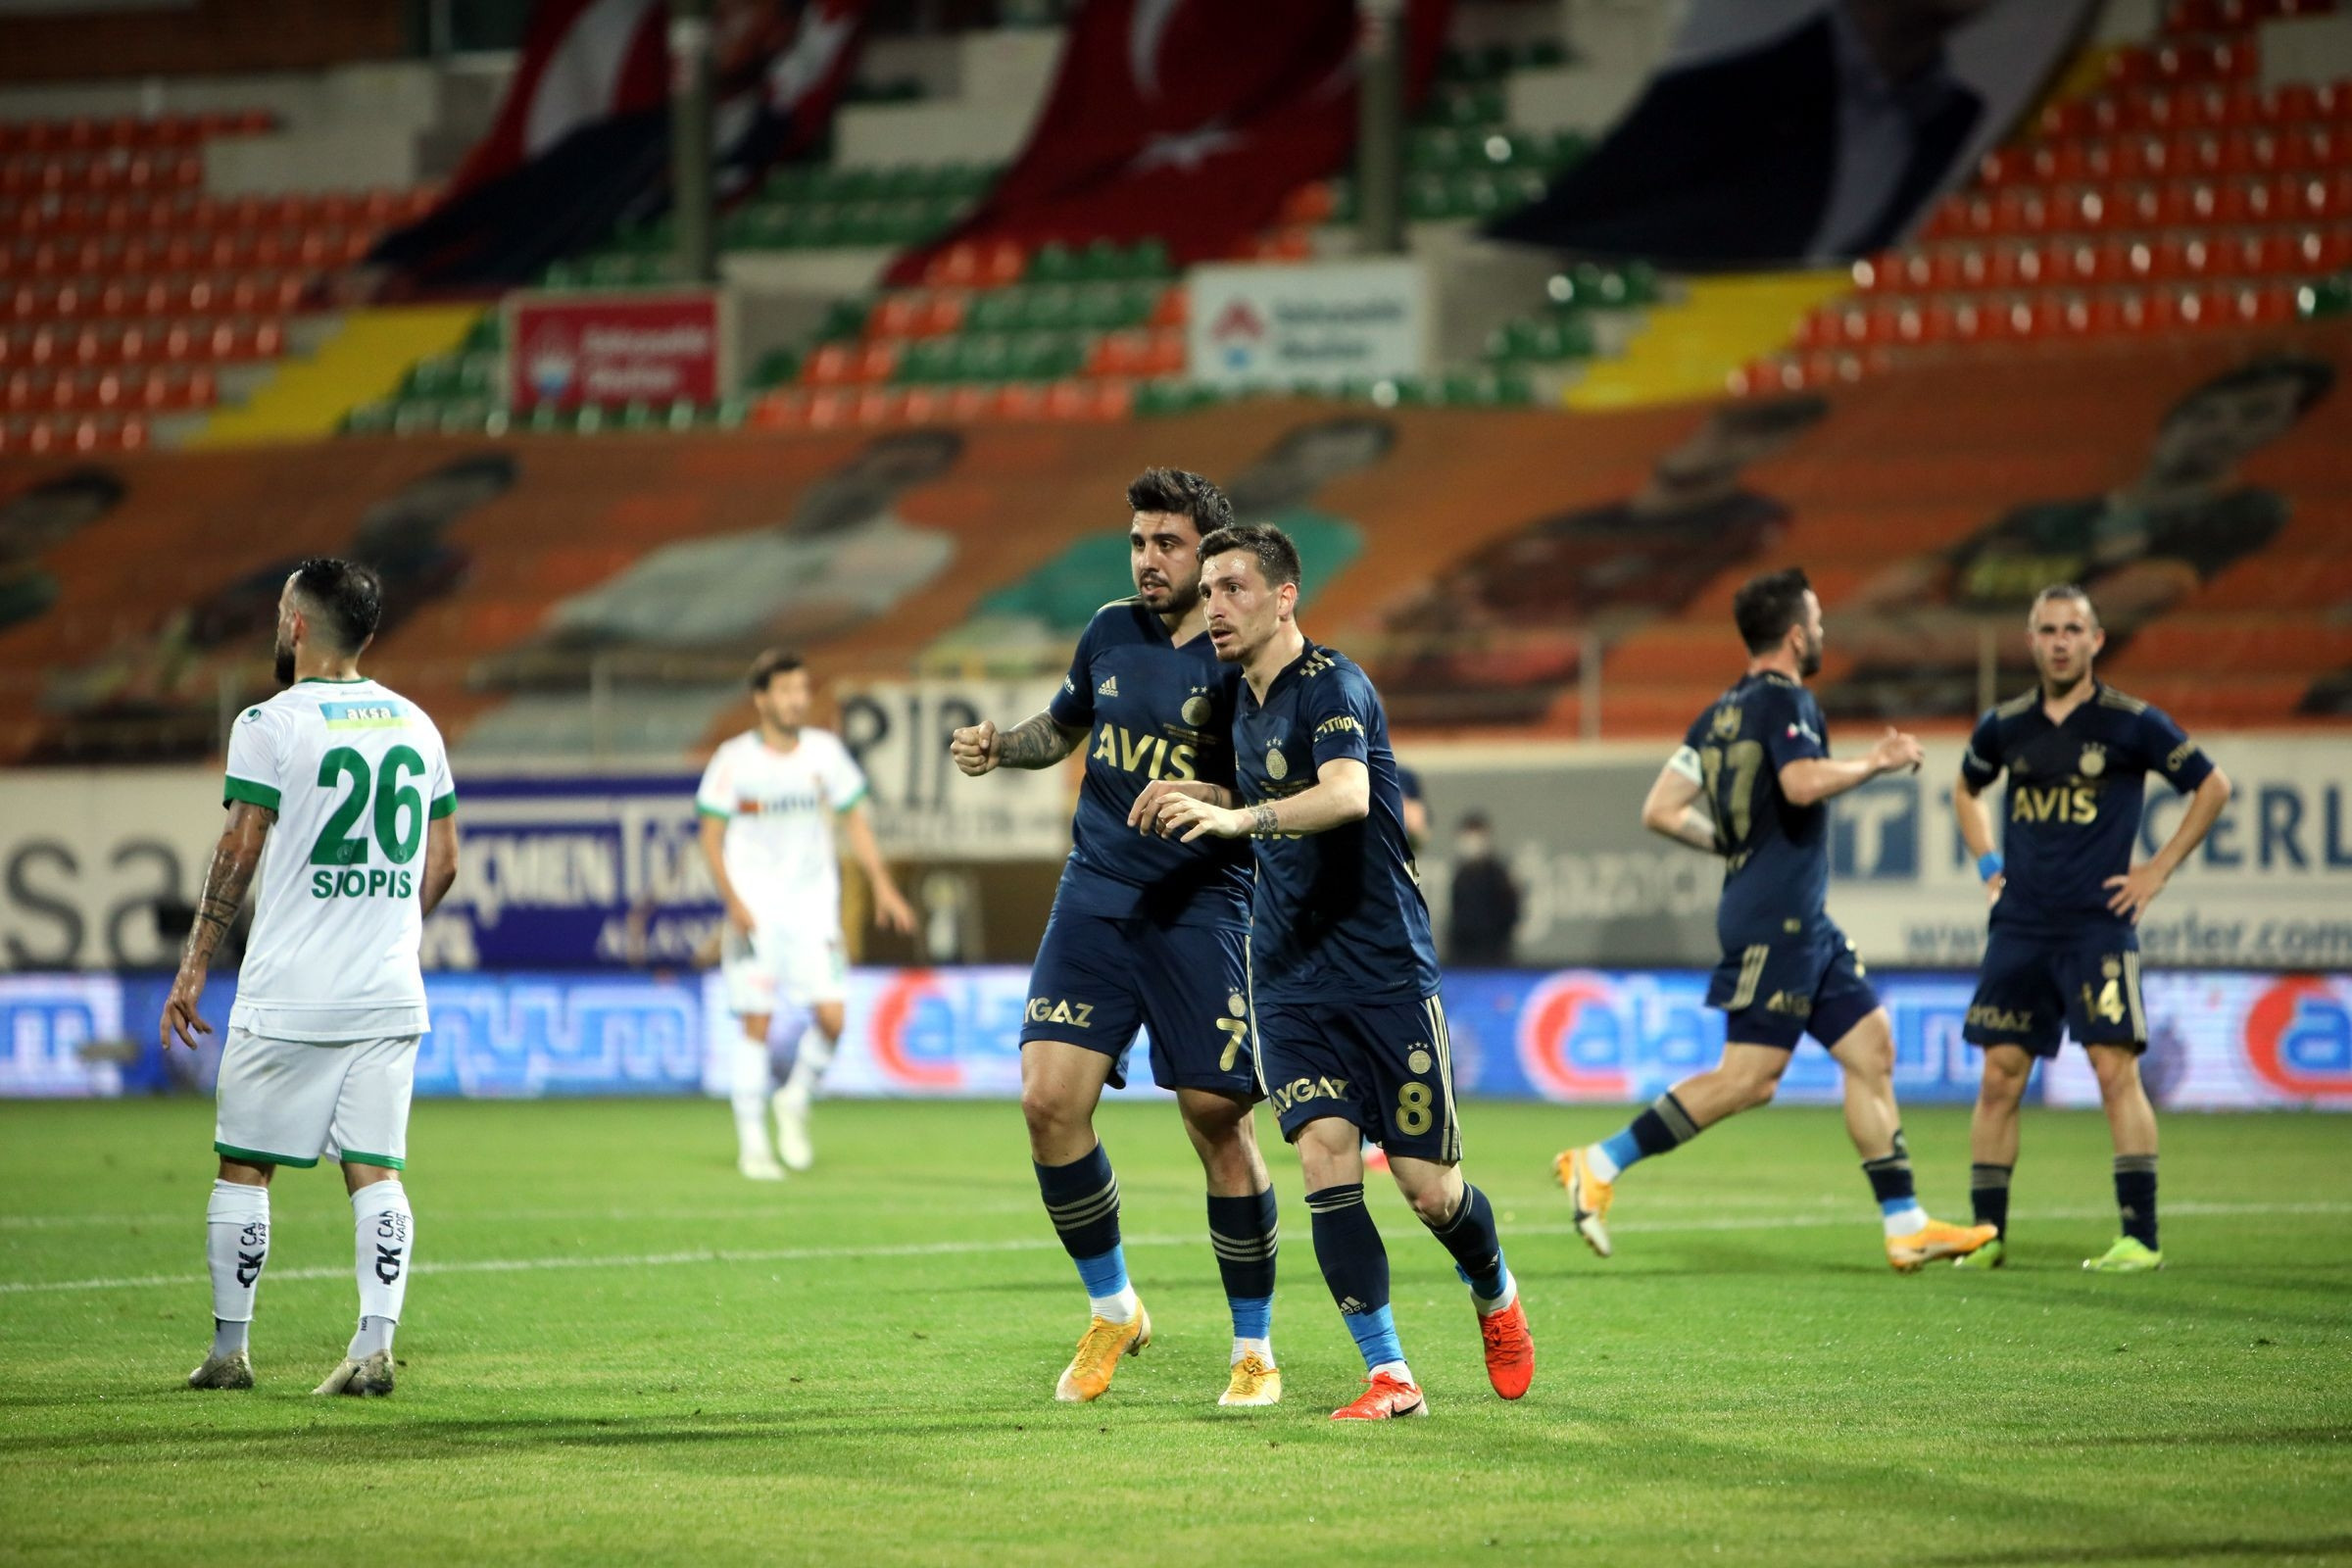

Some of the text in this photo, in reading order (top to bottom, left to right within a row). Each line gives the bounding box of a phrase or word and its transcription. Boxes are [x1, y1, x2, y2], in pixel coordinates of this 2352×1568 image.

[347, 706, 392, 720] aksa
[1093, 722, 1199, 781] AVIS
[310, 744, 426, 866] 26
[2011, 785, 2098, 824] AVIS
[311, 869, 413, 900] SIOPIS
[1024, 998, 1095, 1029] YGAZ
[2082, 978, 2126, 1023] 14
[1216, 1017, 1248, 1071] 7
[1273, 1076, 1349, 1119] AYGAZ
[1396, 1081, 1433, 1136] 8
